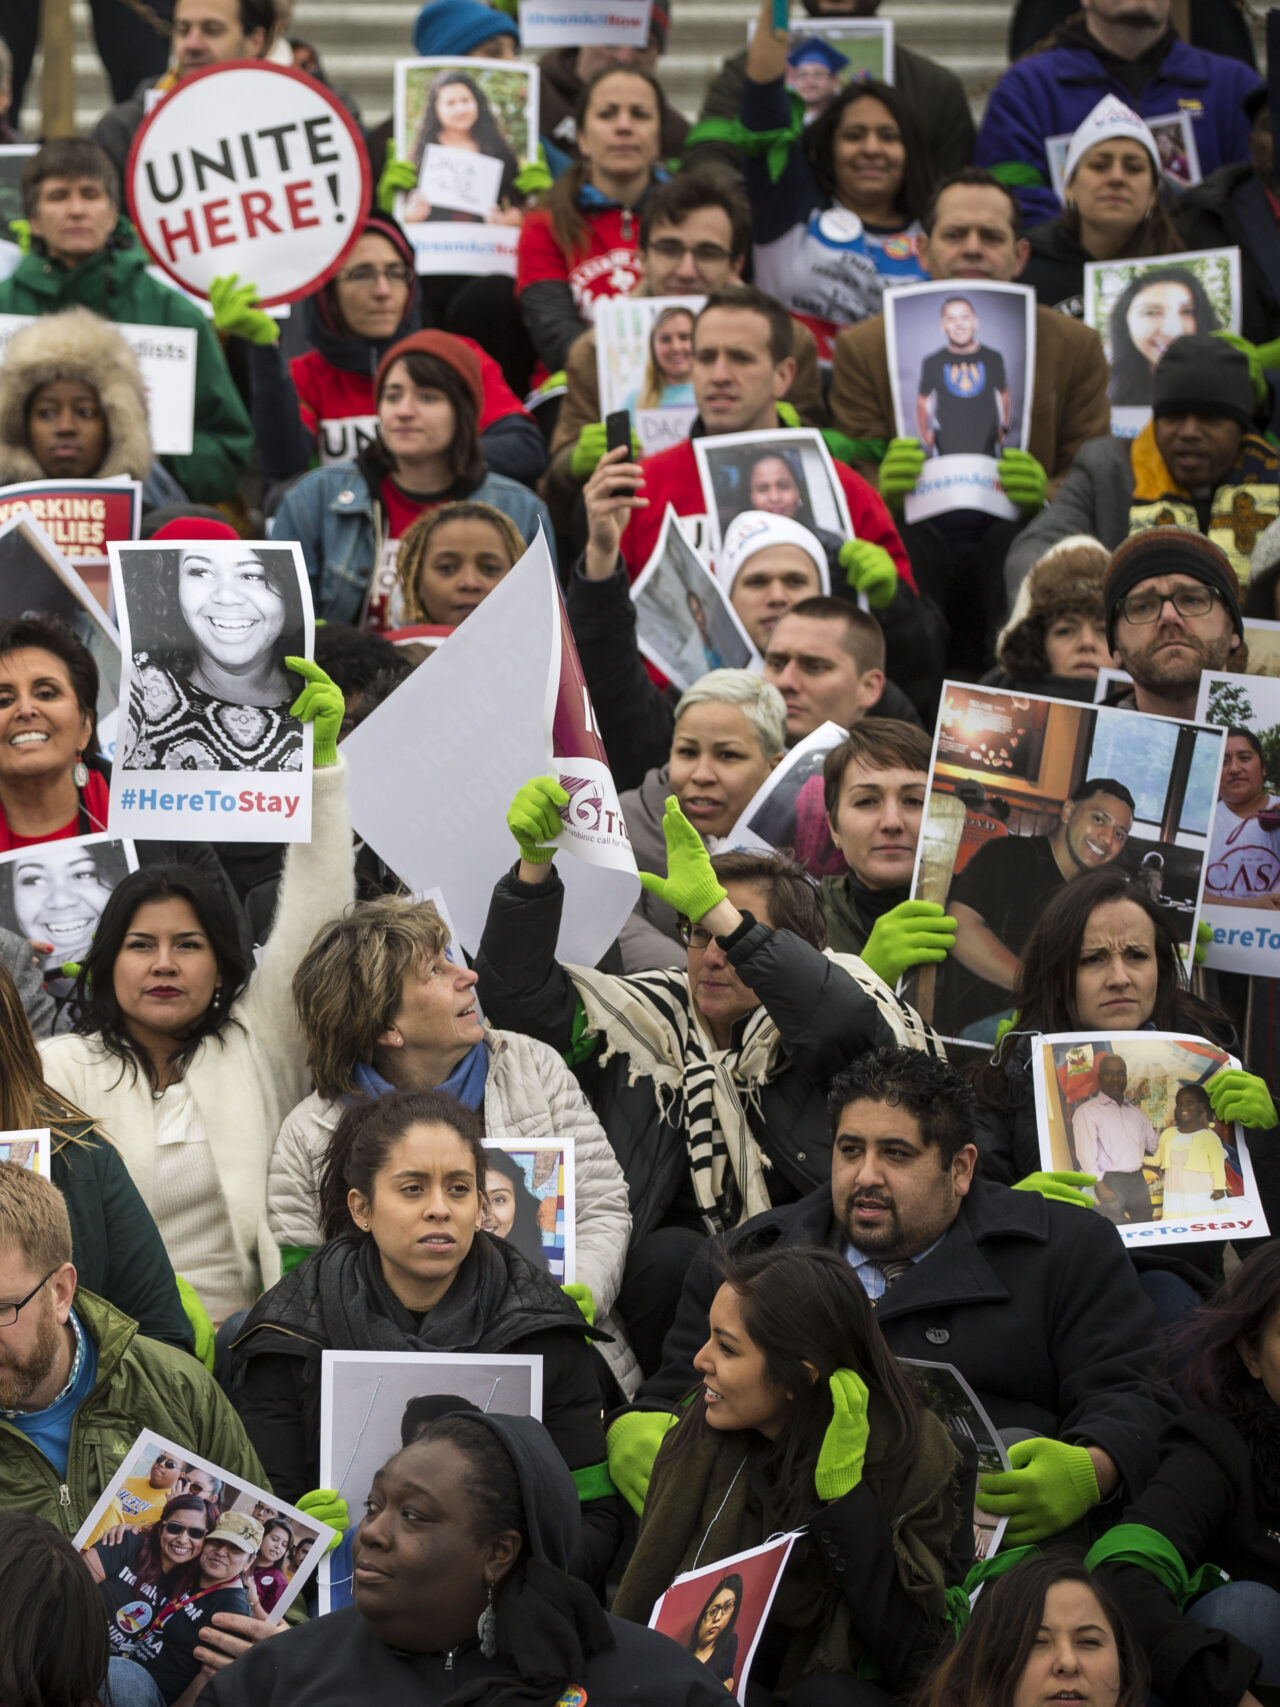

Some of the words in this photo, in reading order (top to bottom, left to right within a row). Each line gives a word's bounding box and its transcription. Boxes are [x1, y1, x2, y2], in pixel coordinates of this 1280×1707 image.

[145, 115, 339, 203] UNITE
[120, 788, 300, 818] #HereToStay
[597, 833, 611, 846] call
[1120, 1219, 1254, 1239] reToStay
